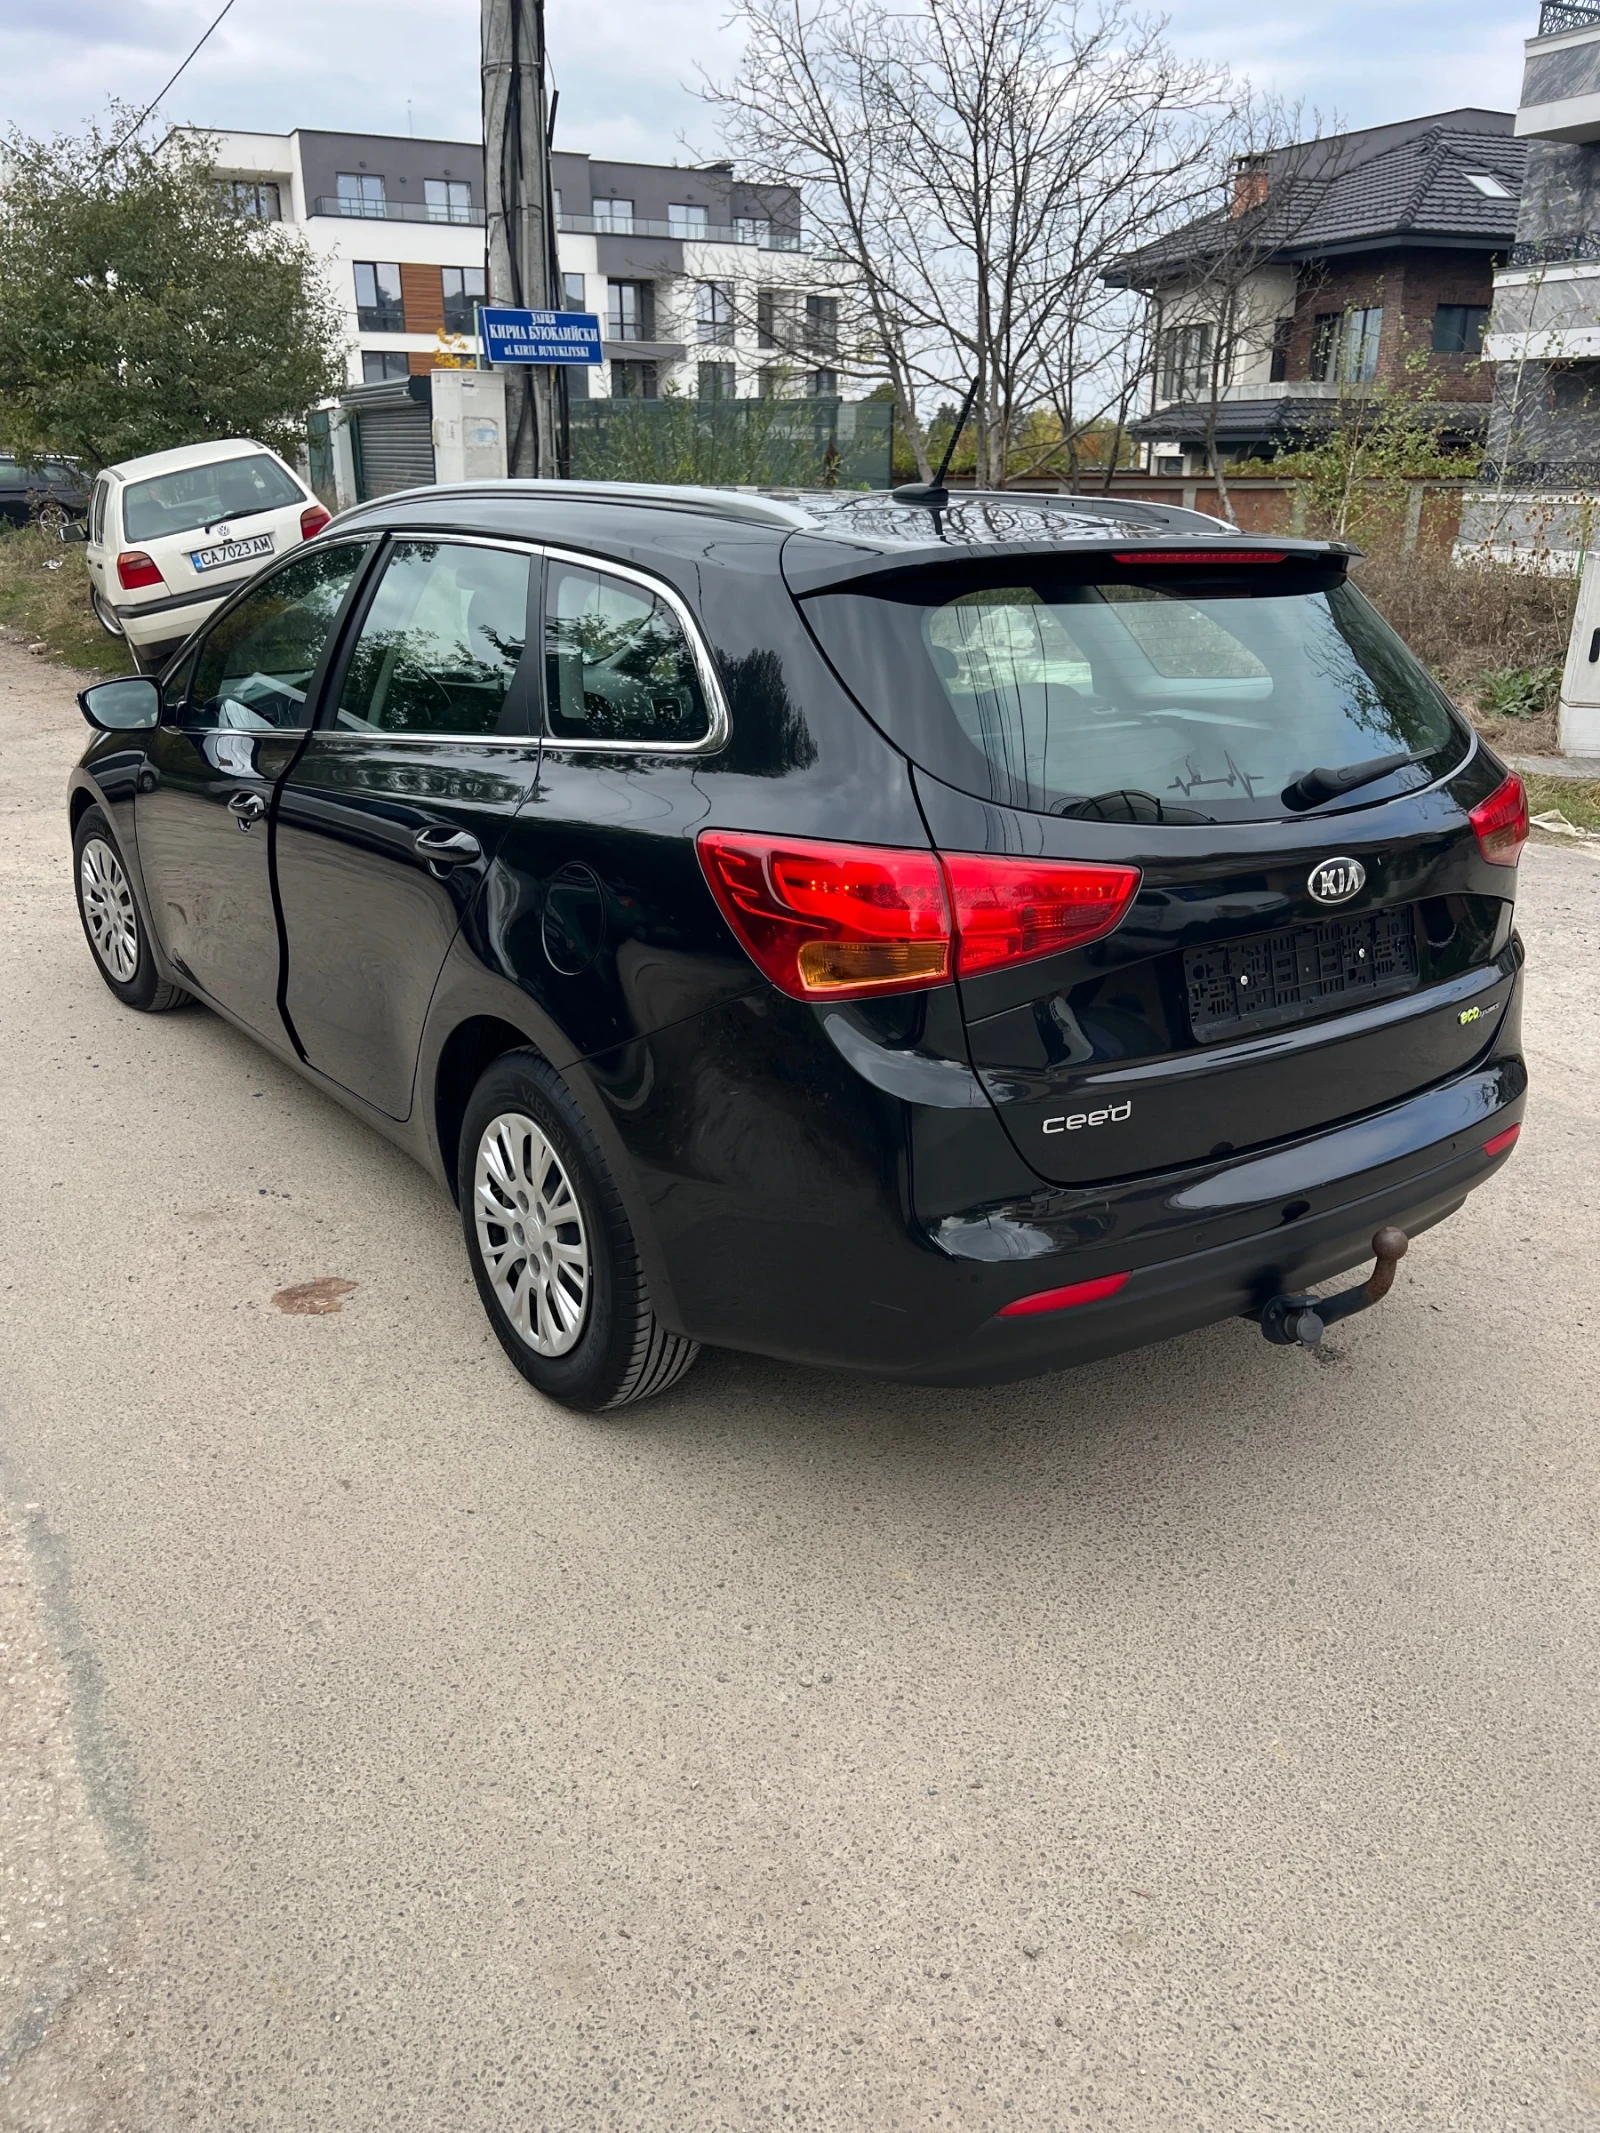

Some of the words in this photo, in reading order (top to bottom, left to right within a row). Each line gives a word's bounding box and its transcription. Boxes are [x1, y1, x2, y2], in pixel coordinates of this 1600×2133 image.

[489, 324, 527, 340] КИРИЛ
[528, 325, 598, 342] БУЮКЛИЙСКИ
[514, 345, 537, 356] KIRIL
[539, 346, 589, 357] BUYUKLIYSKI
[253, 537, 270, 552] AM
[1320, 866, 1358, 896] KIA
